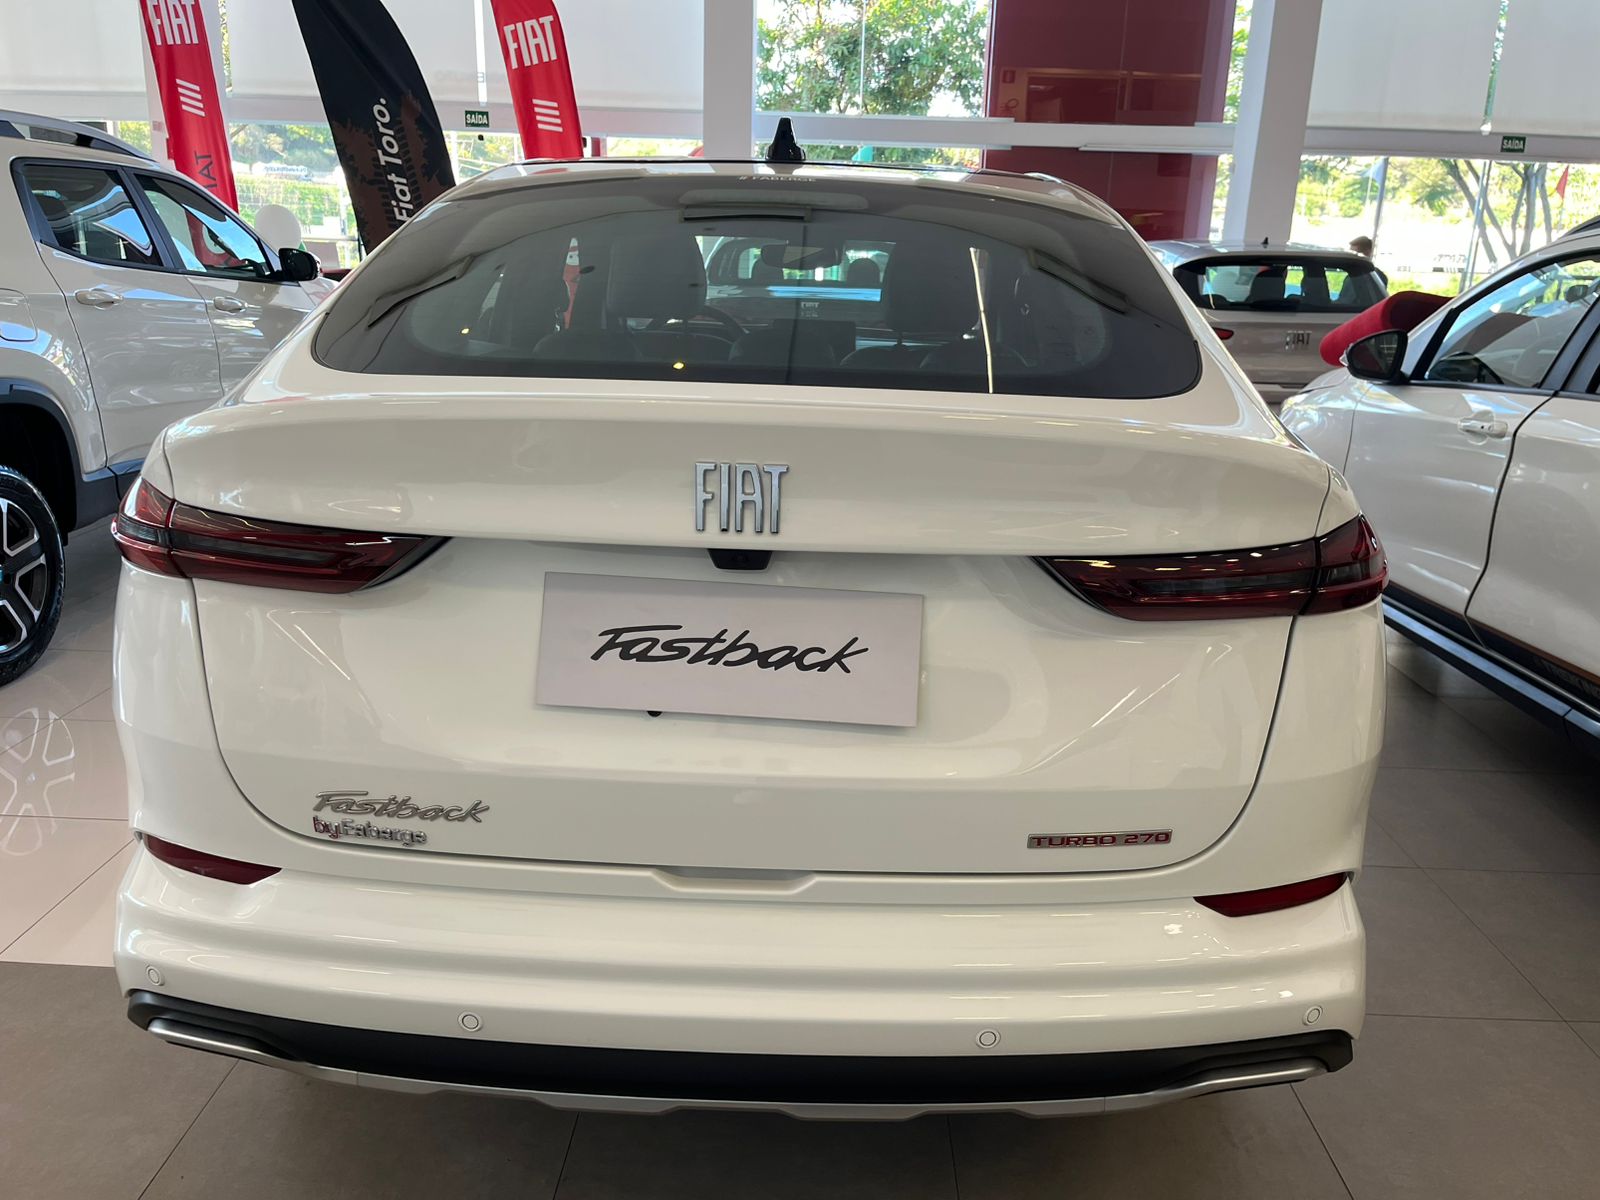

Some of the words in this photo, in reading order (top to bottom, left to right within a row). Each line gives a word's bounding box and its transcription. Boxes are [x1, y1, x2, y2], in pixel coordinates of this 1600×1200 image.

[146, 0, 200, 46] FIAT
[503, 15, 558, 70] FIAT
[373, 98, 402, 166] Toro.
[466, 112, 488, 125] SAÍDA
[1503, 139, 1524, 150] SAÍDA
[194, 151, 218, 190] IAT
[387, 173, 413, 221] Fiat
[695, 462, 789, 534] FIAT
[591, 625, 868, 674] Fastback
[313, 790, 490, 823] Fastback
[1031, 835, 1117, 847] TURBO
[1124, 832, 1170, 844] 270
